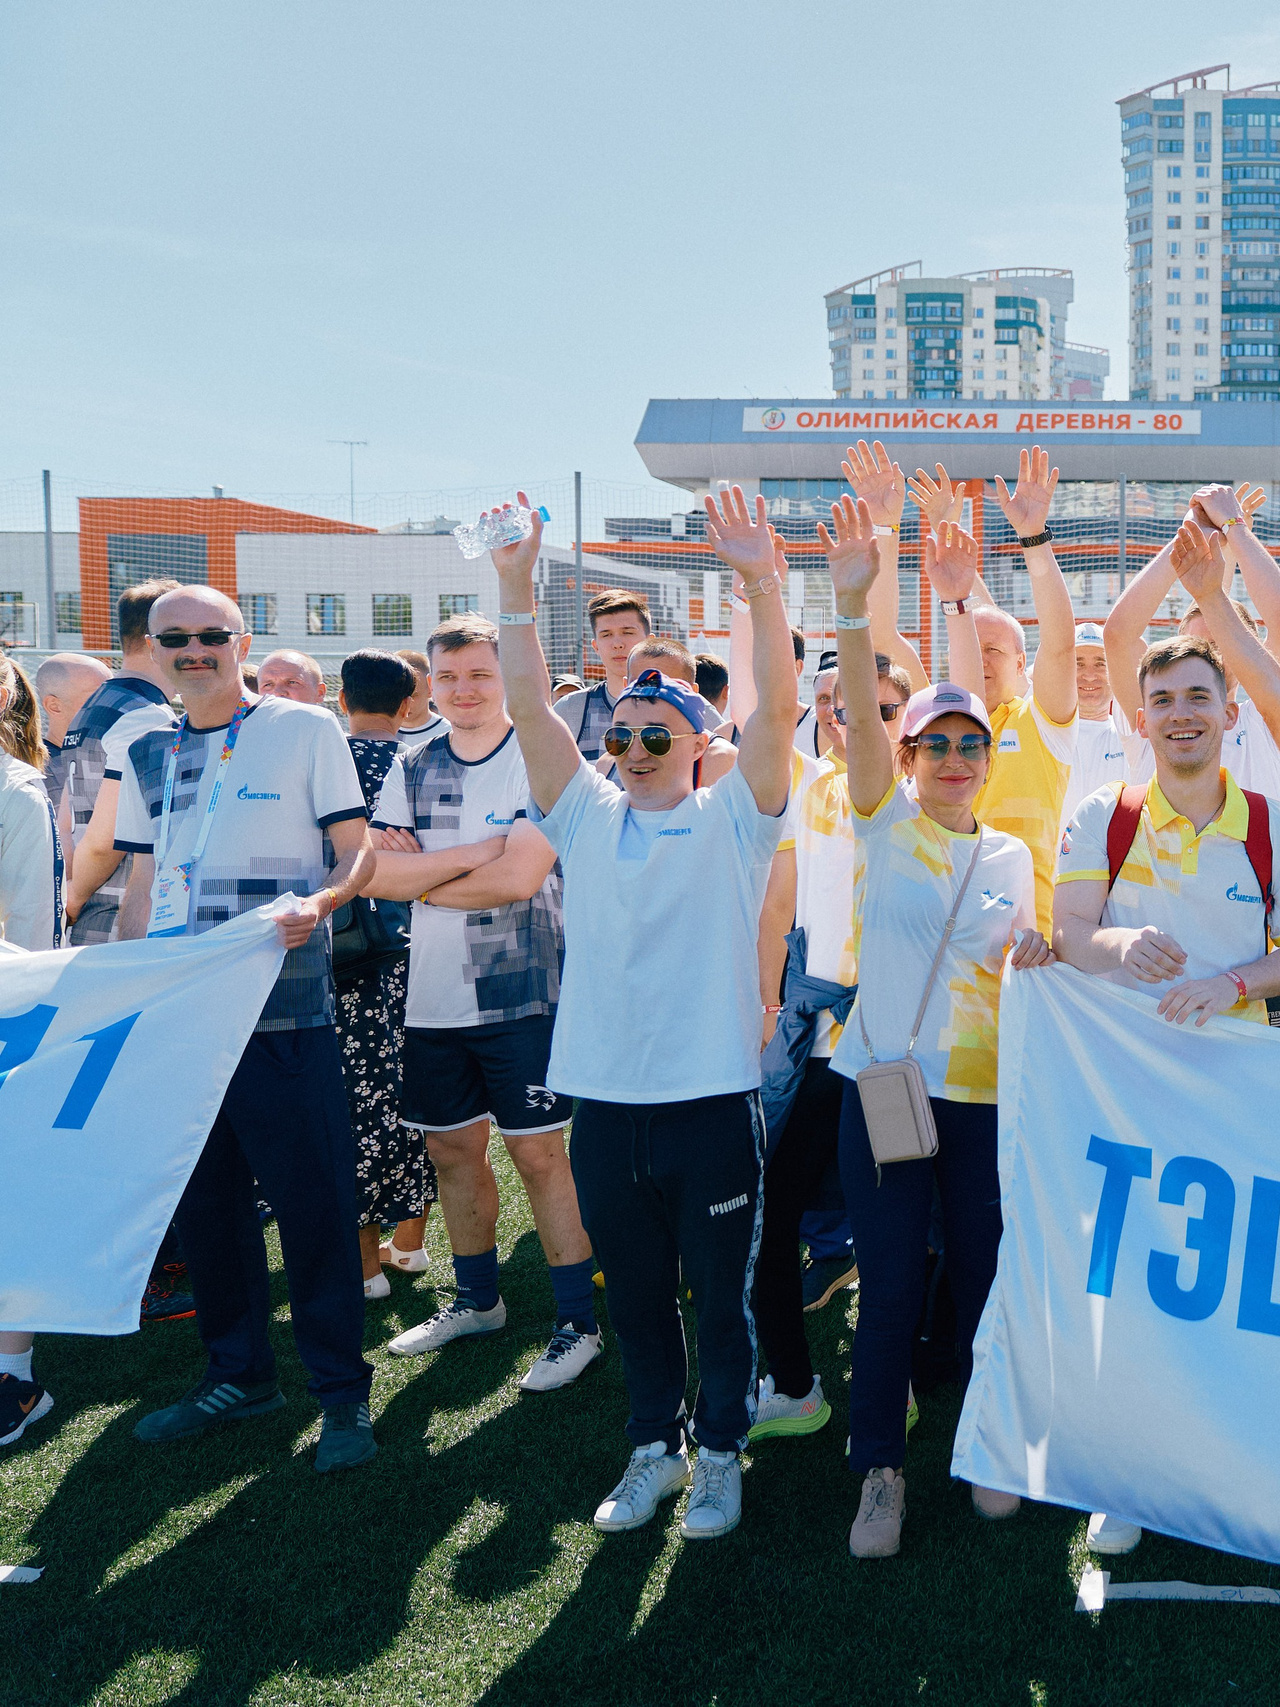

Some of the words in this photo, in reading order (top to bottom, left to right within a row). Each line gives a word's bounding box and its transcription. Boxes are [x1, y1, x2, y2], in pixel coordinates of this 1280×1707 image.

[796, 409, 998, 429] ОЛИМПИЙСКАЯ
[1015, 413, 1132, 433] ДЕРЕВНЯ
[1152, 414, 1183, 430] 80
[709, 1193, 749, 1217] PUMA
